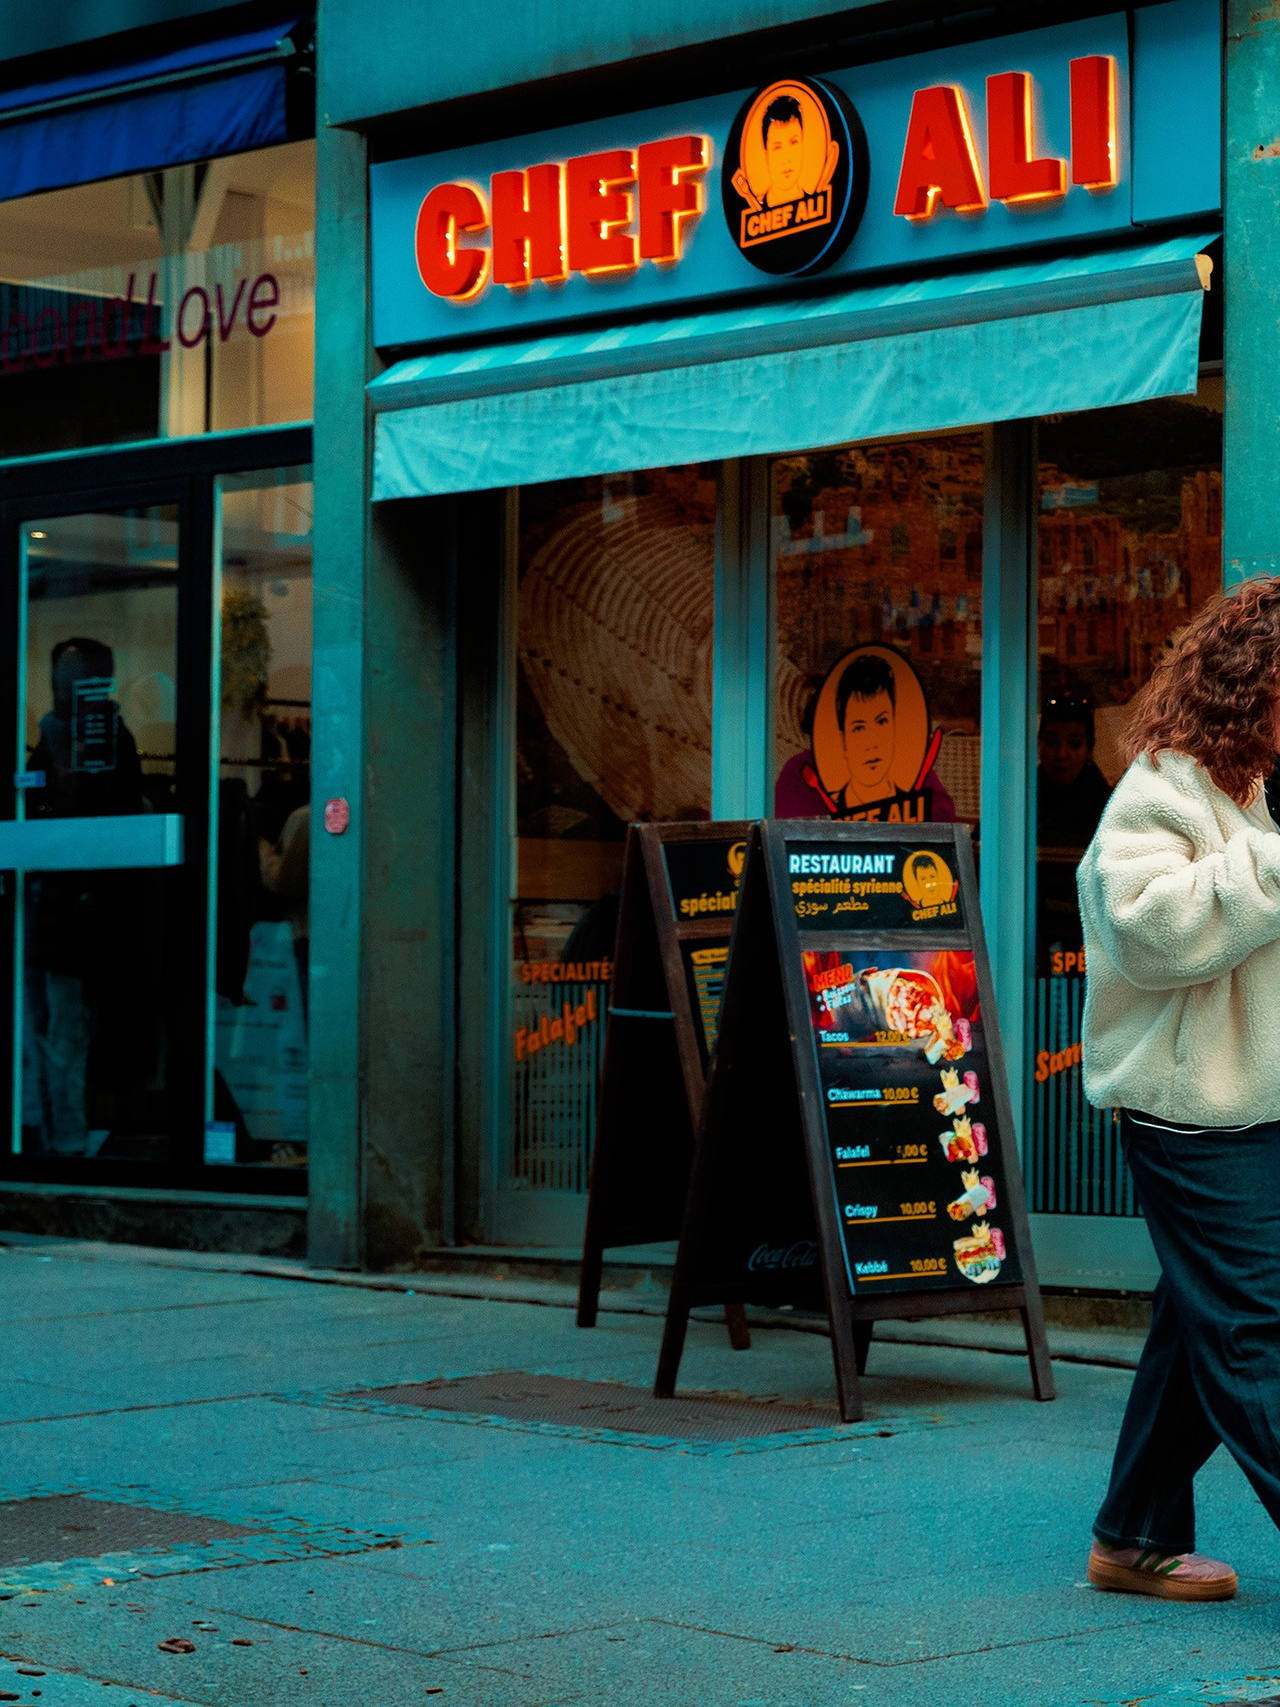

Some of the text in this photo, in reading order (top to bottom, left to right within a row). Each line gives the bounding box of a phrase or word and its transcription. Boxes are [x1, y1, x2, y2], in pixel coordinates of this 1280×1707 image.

[415, 55, 1119, 300] CHEF ALI
[747, 195, 824, 236] CHEF ALI
[789, 855, 895, 873] RESTAURANT
[792, 878, 903, 897] spécialité syrienne
[832, 897, 870, 914] مطعم
[912, 903, 957, 921] CHEF ALI
[514, 989, 596, 1062] Falafel
[819, 1030, 850, 1043] Tacos
[835, 1145, 871, 1160] Falafel
[844, 1203, 878, 1219] Crispy
